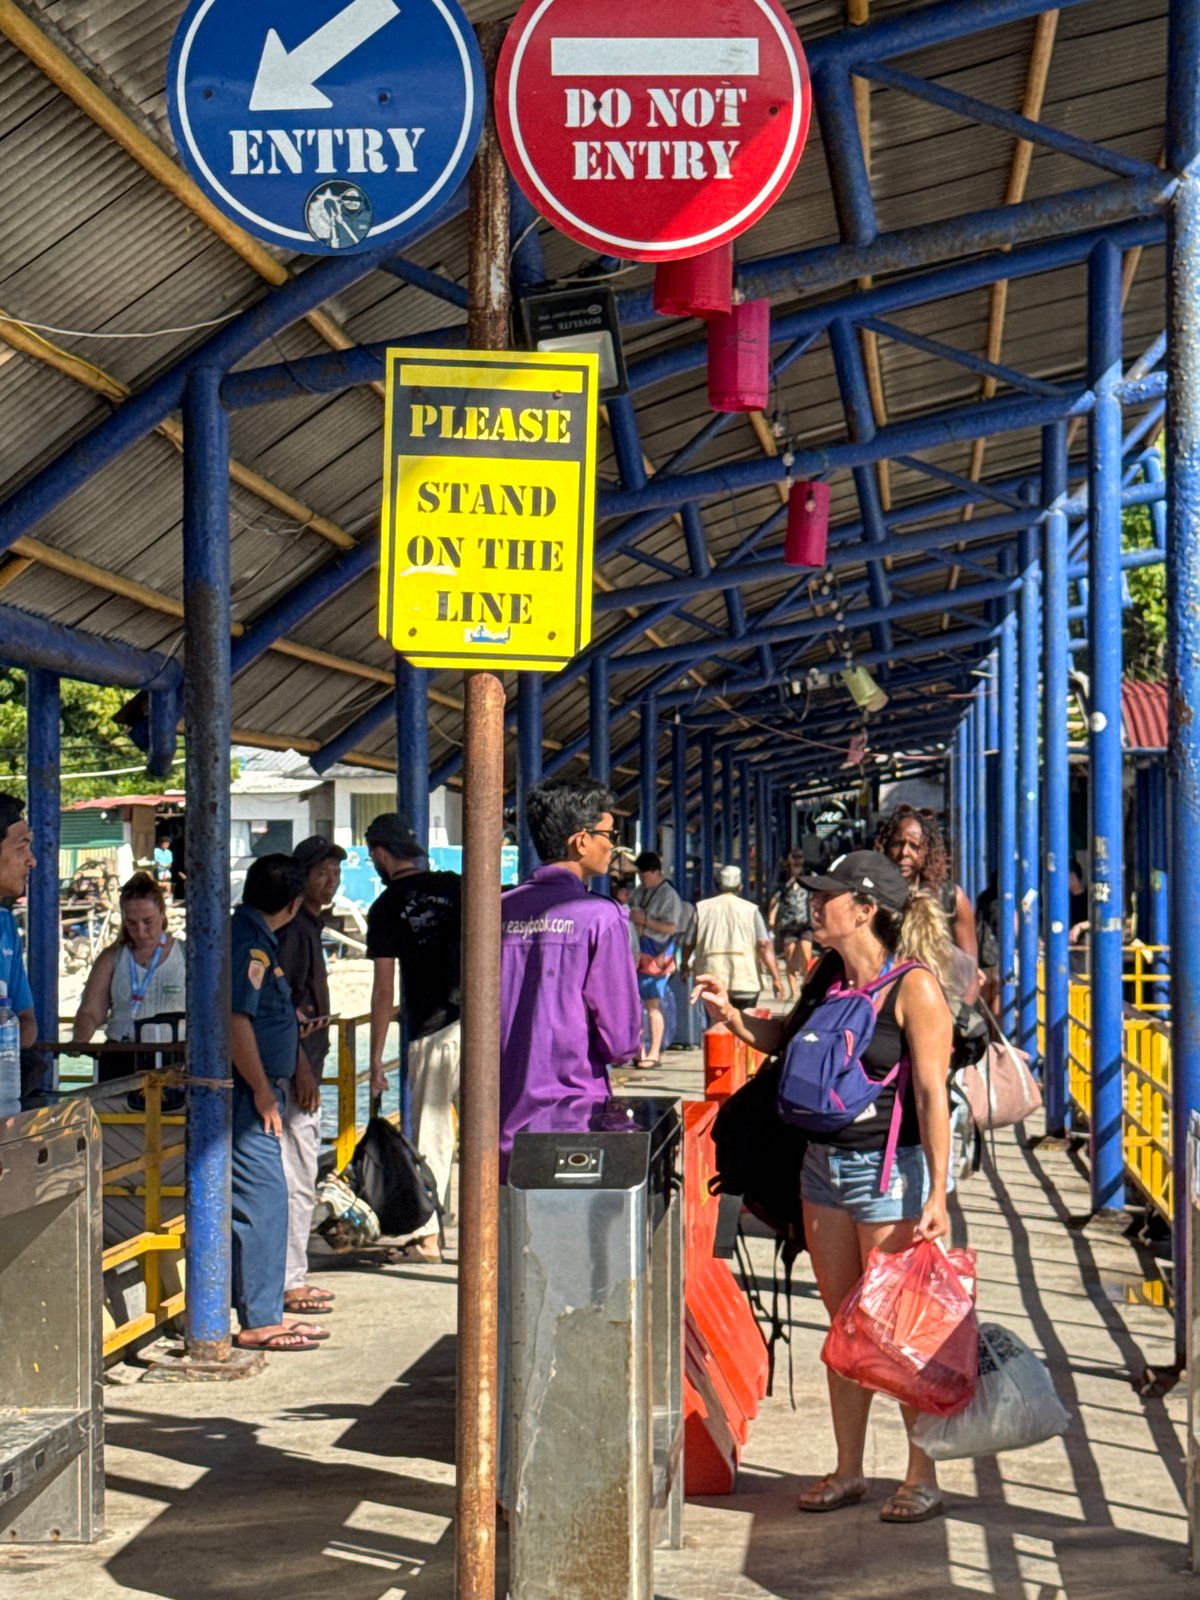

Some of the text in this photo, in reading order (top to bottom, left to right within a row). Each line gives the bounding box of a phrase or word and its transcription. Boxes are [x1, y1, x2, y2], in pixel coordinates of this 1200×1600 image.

[564, 87, 747, 128] DO NOT
[229, 128, 425, 175] ENTRY
[573, 141, 740, 180] ENTRY
[409, 404, 571, 444] PLEASE
[417, 481, 557, 518] STAND
[407, 535, 564, 571] ON THE
[436, 591, 532, 624] LINE
